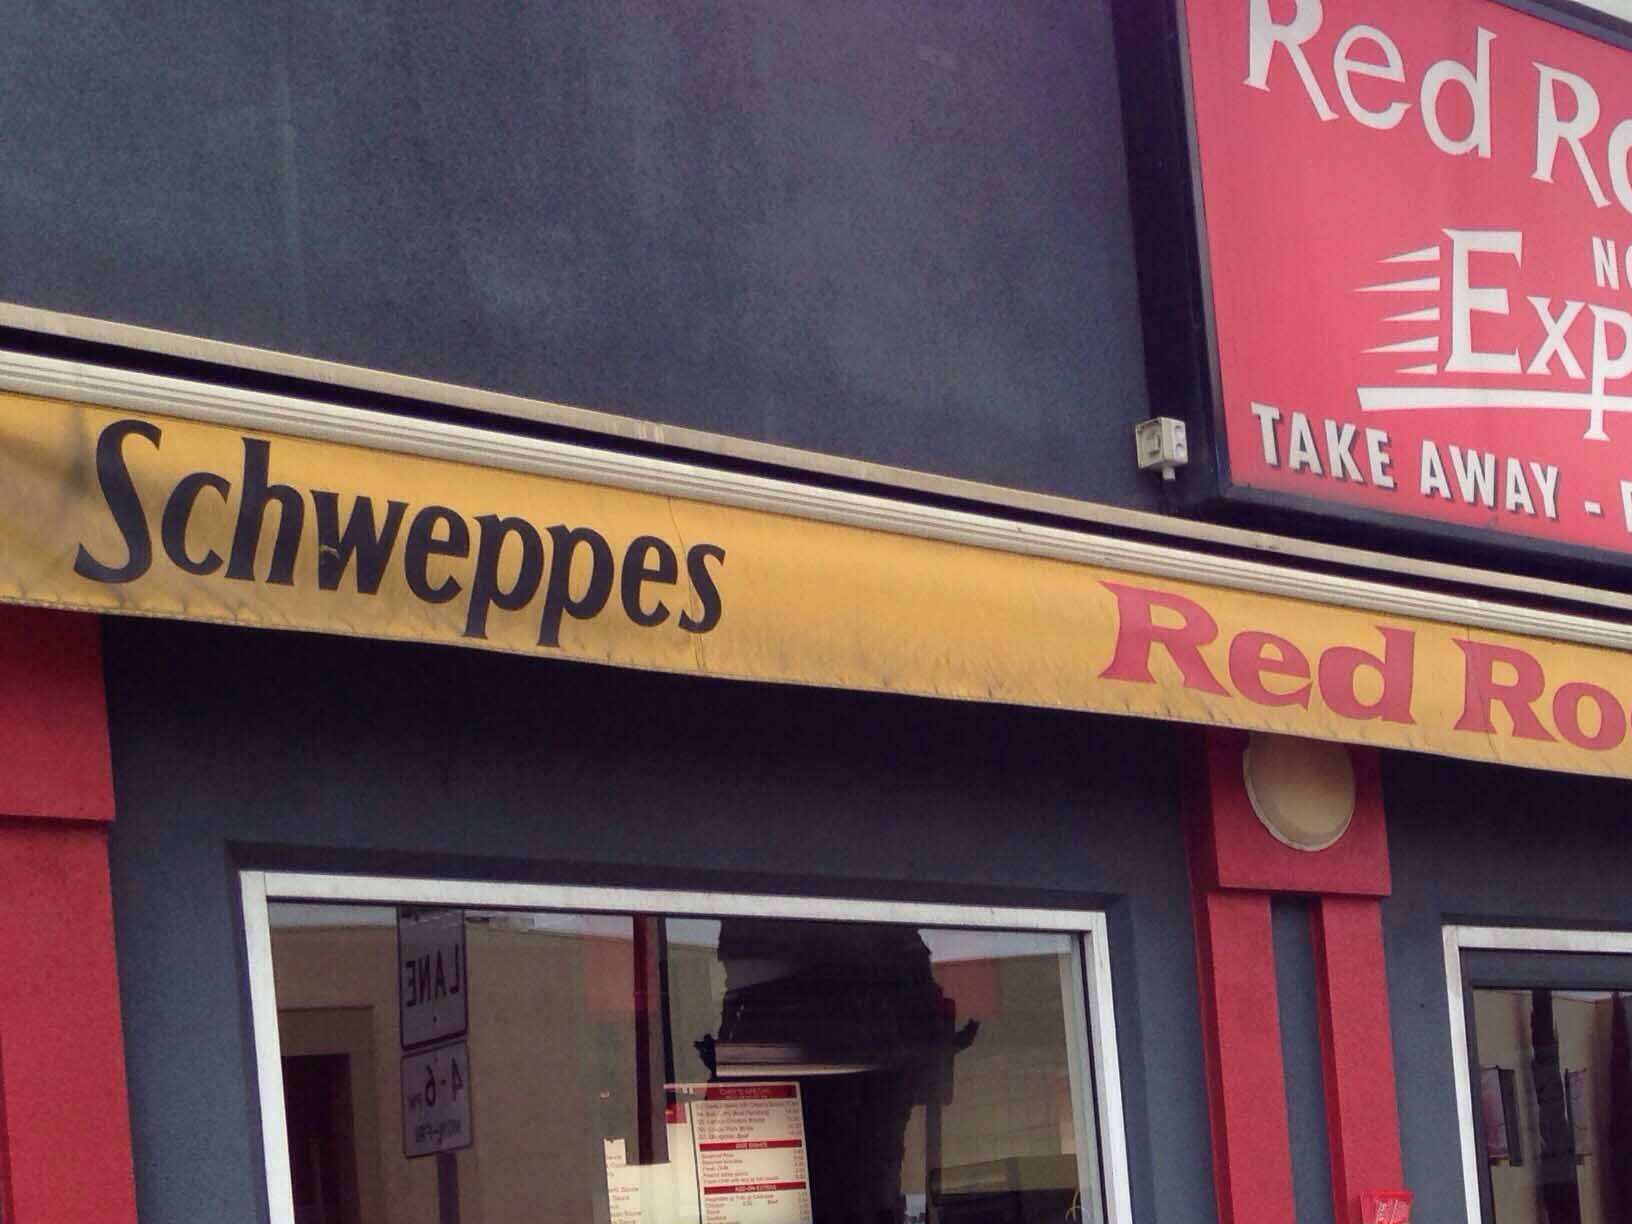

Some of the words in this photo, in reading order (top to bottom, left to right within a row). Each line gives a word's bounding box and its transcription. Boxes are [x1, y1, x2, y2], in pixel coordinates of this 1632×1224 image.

[1243, 0, 1498, 159] Red
[73, 418, 728, 648] Schweppes
[1250, 400, 1397, 490] TAKE
[1419, 439, 1560, 520] AWAY
[1098, 578, 1417, 727] Red
